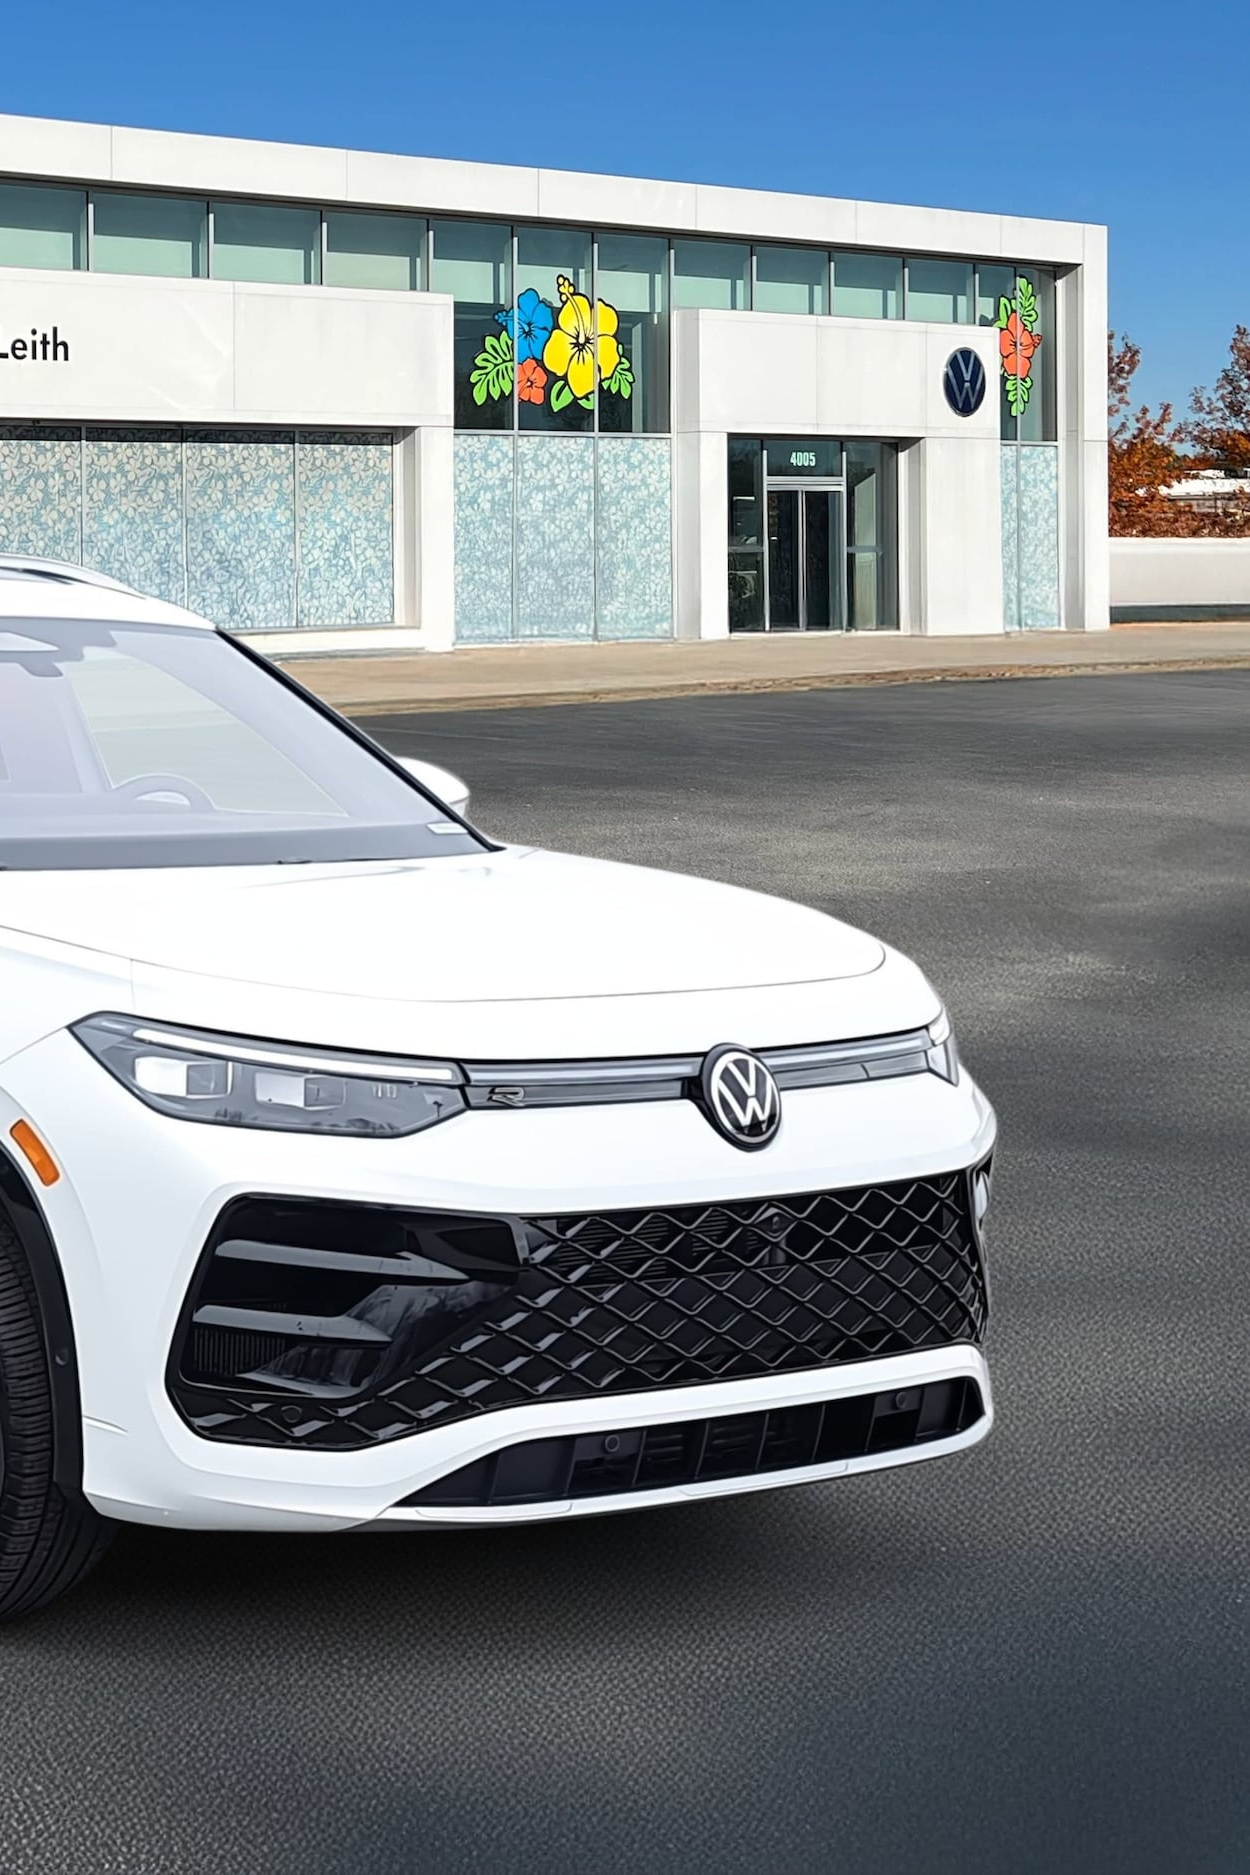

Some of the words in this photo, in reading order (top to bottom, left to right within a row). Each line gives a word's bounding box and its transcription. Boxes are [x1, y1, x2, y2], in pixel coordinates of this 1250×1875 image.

[945, 349, 985, 412] VW
[790, 452, 816, 466] 4005
[713, 1054, 777, 1138] VW
